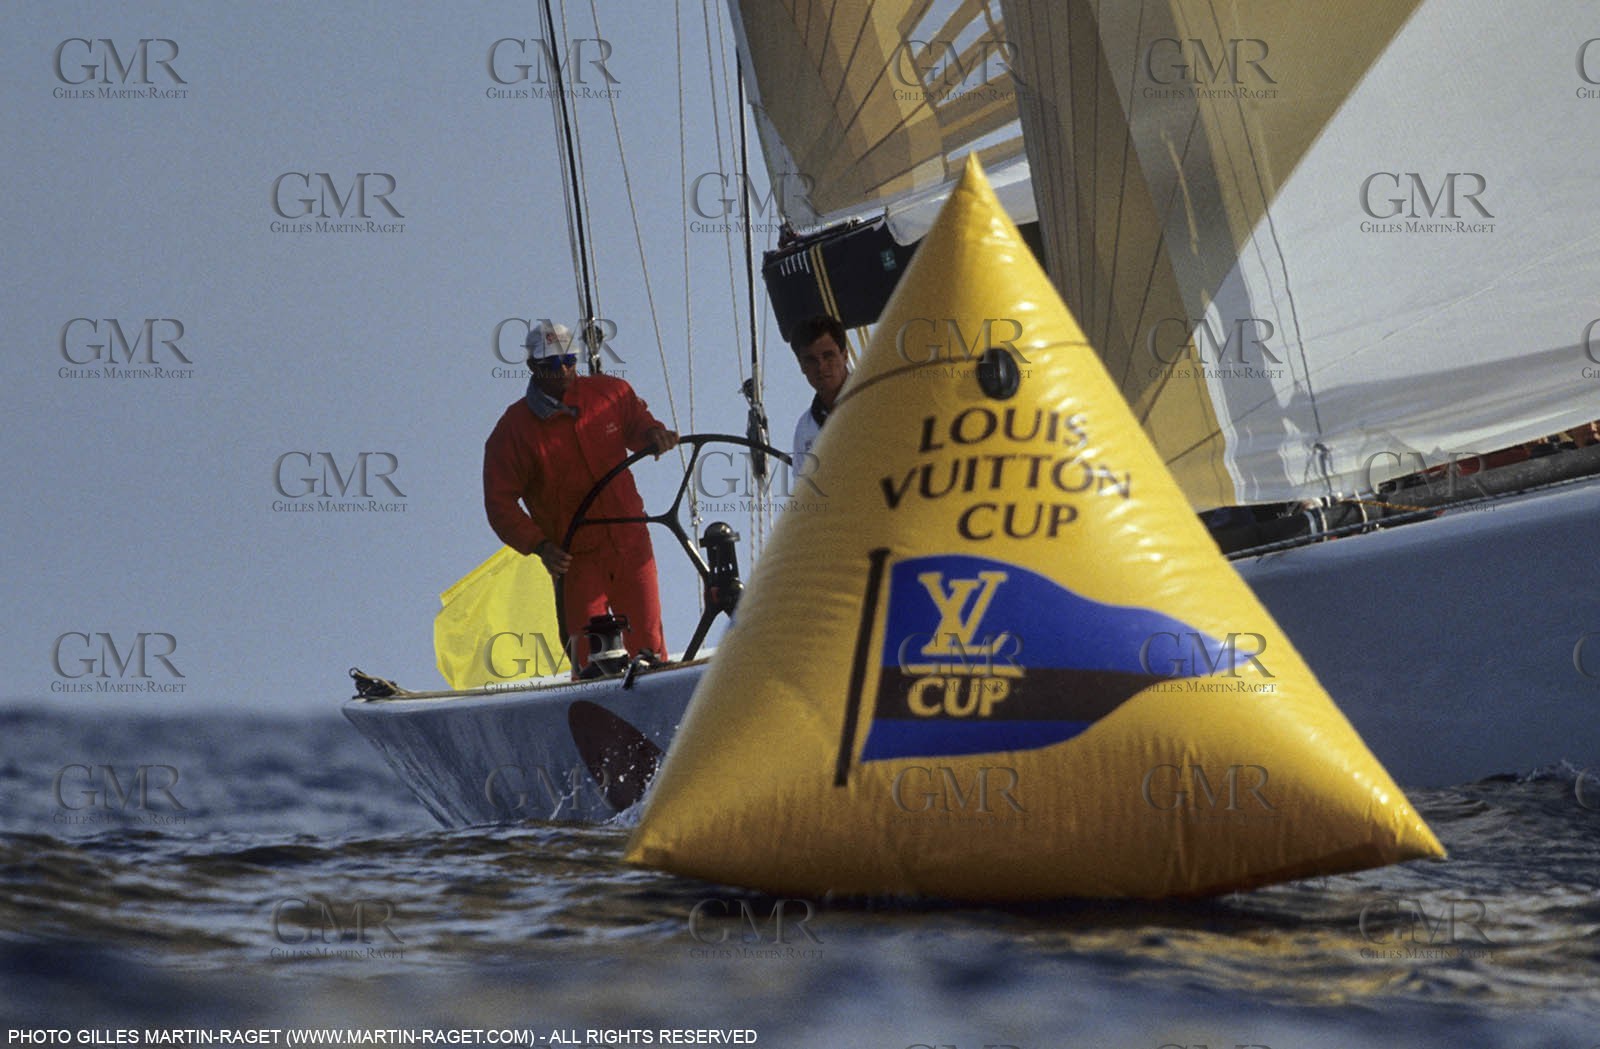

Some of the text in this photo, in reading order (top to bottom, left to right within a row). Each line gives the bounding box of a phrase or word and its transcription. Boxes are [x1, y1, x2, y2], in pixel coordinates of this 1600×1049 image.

[918, 407, 1088, 453] LOUIS
[880, 455, 1131, 509] VUITTON
[957, 503, 1078, 541] CUP
[907, 677, 1010, 716] CUP
